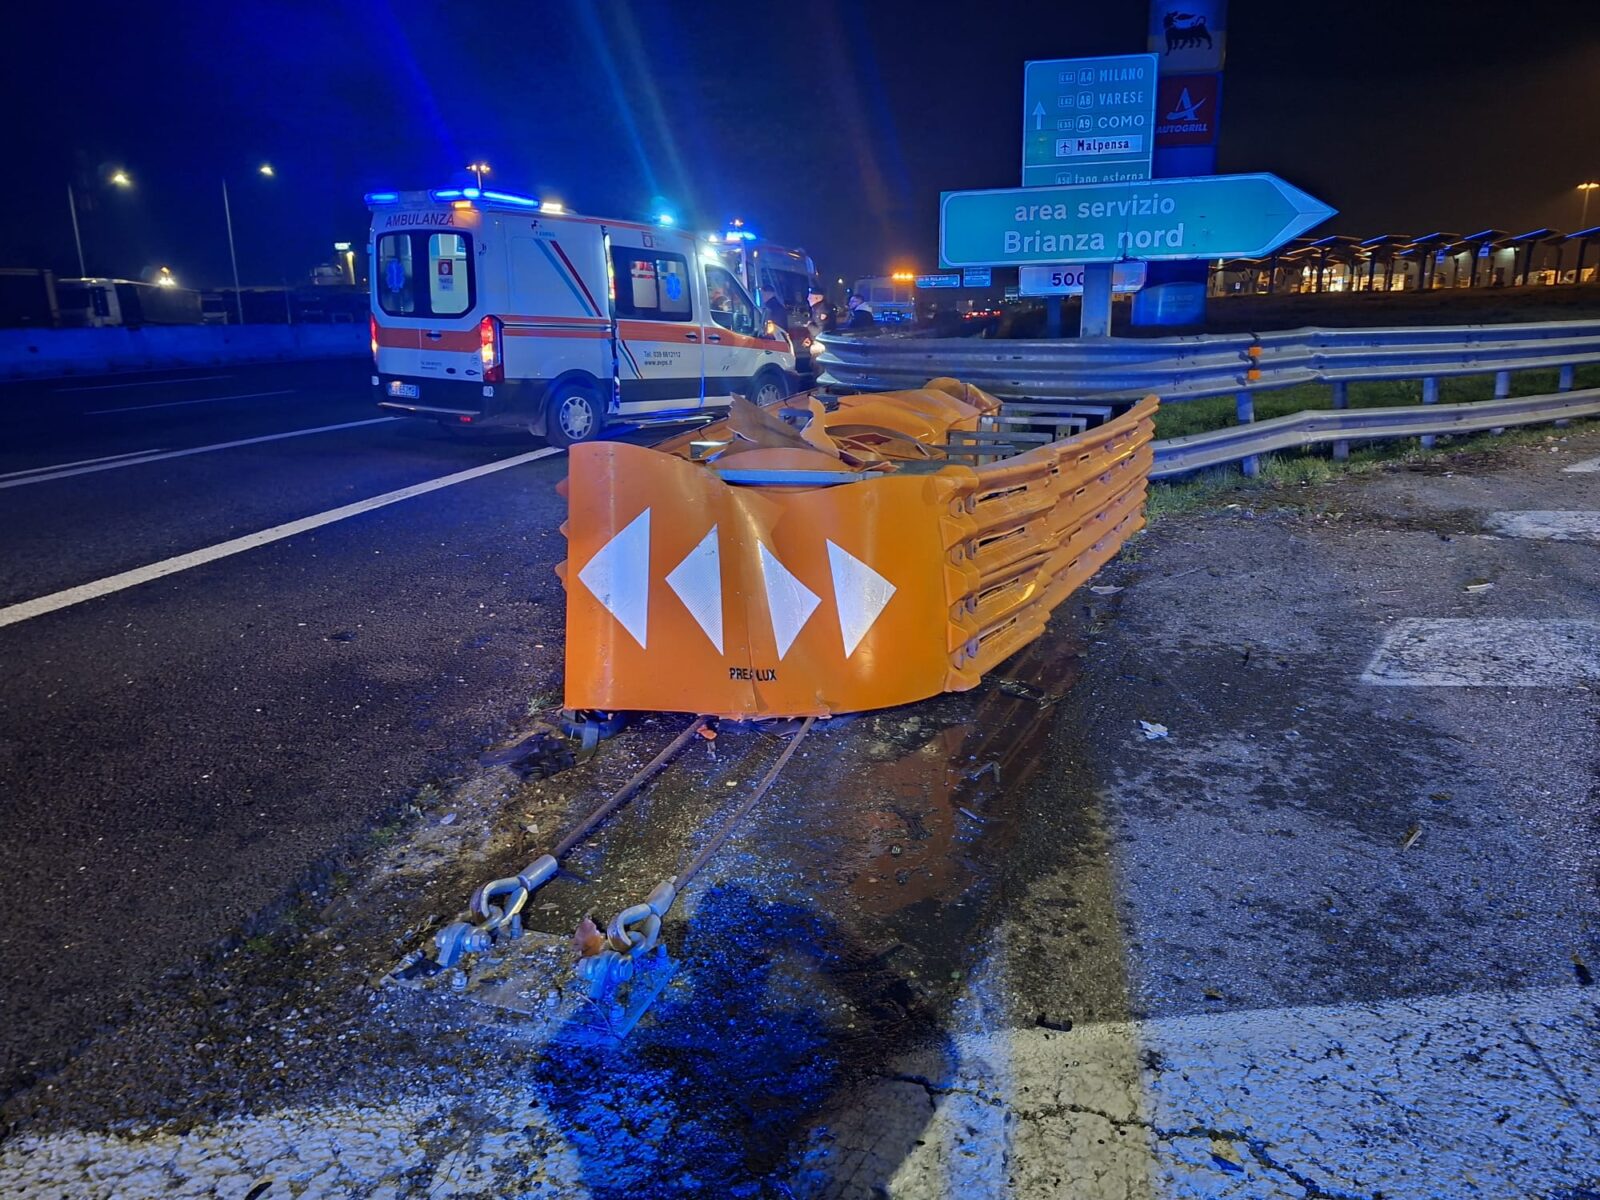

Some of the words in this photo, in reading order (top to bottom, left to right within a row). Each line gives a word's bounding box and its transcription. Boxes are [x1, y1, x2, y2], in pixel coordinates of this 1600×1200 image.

[1080, 71, 1092, 83] A4
[1100, 68, 1144, 82] MILANO
[1079, 95, 1091, 106] A8
[1099, 91, 1144, 105] VARESE
[1078, 118, 1090, 129] A9
[1098, 114, 1145, 129] COMO
[1157, 123, 1208, 134] AUTOGRILL
[1077, 139, 1129, 153] Malpensa
[1014, 203, 1067, 222] area
[1077, 193, 1176, 219] servizio
[385, 213, 455, 227] AMBULANZA
[1004, 229, 1105, 254] Brianza
[1118, 222, 1185, 249] nord
